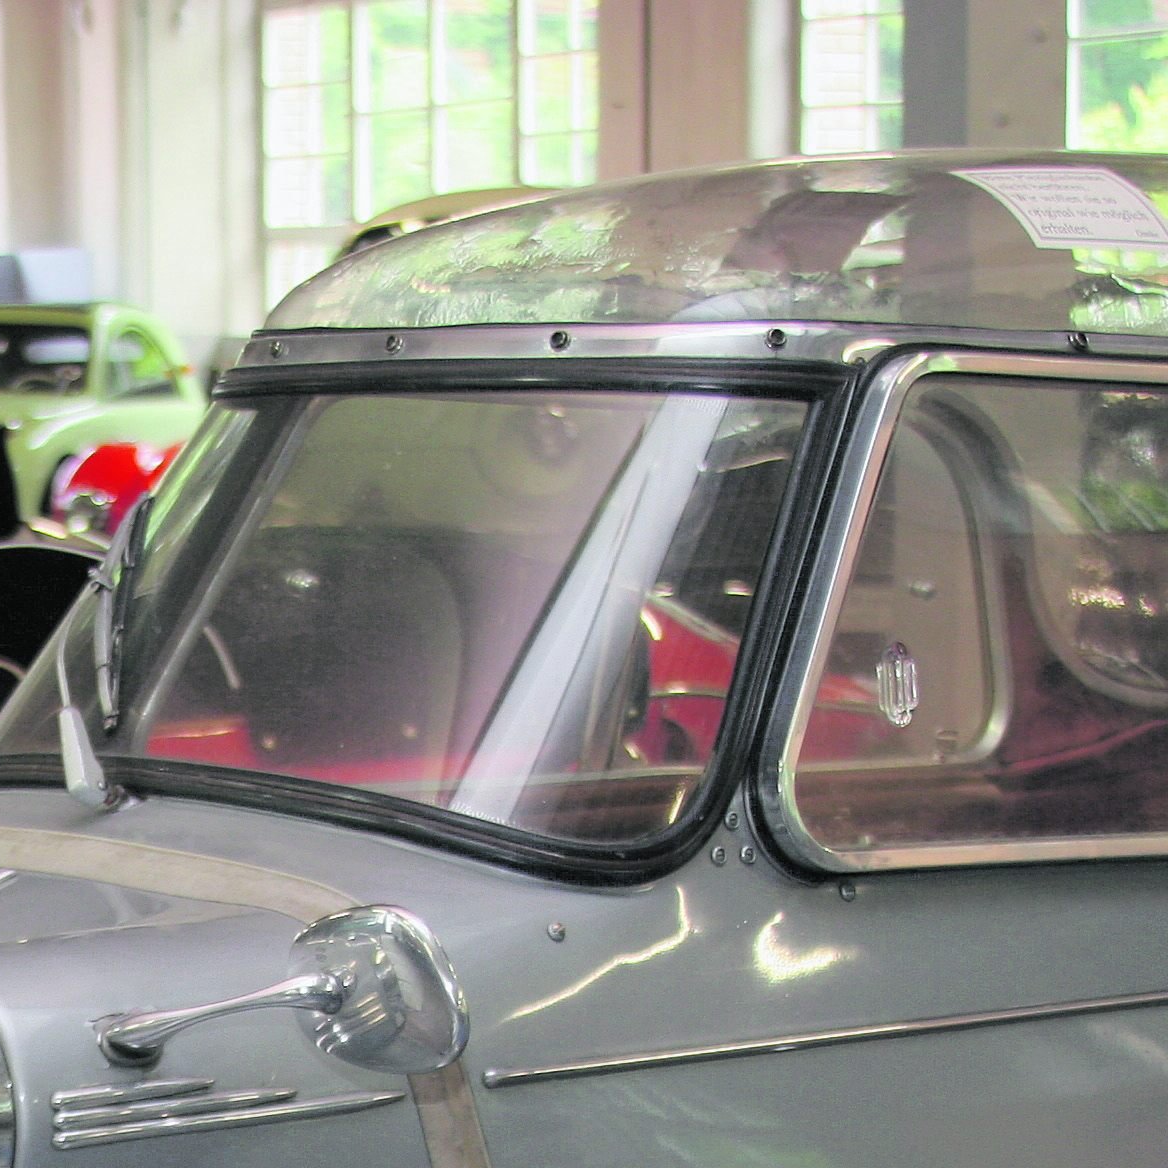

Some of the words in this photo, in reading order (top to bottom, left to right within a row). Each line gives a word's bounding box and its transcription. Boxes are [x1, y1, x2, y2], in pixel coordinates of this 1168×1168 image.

[1027, 207, 1073, 219] original
[1076, 209, 1099, 218] wie
[1102, 209, 1149, 223] möglich
